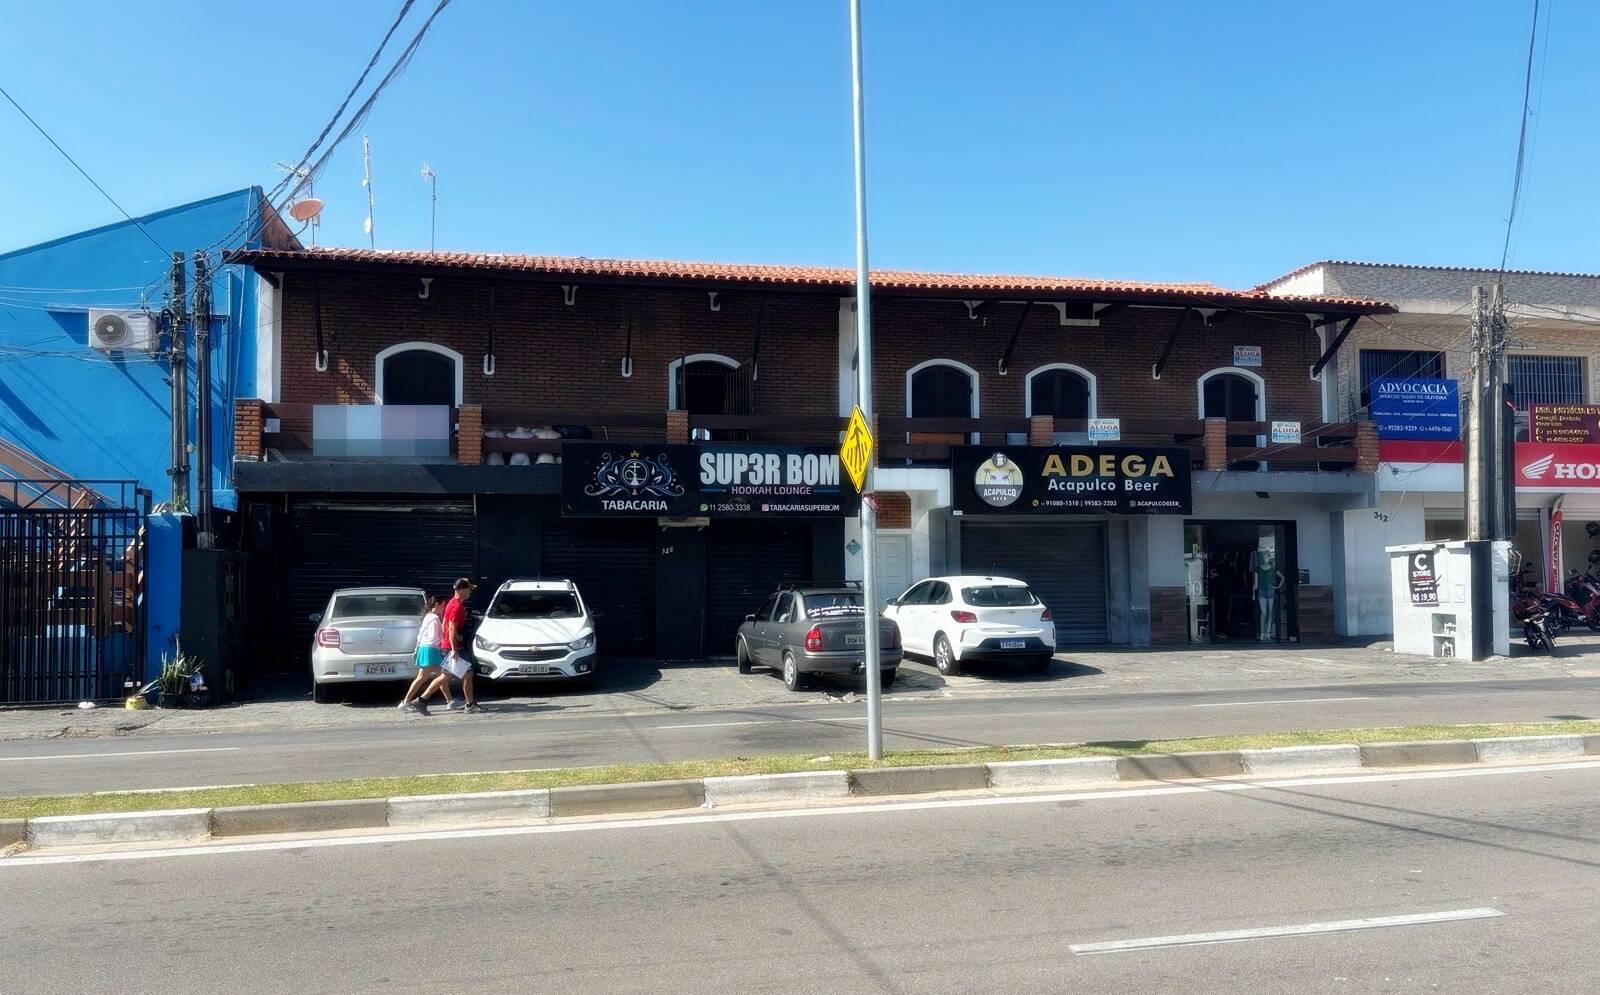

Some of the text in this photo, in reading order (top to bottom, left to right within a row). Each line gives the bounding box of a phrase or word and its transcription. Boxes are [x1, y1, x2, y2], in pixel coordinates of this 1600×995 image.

[1378, 382, 1448, 394] ADVOCACIA
[700, 452, 840, 486] SUP3R BOM
[1042, 454, 1174, 477] ADEGA
[731, 486, 812, 495] HOOKAH LOUNGE
[1048, 479, 1159, 493] Acapulco Beer
[983, 488, 1017, 498] ACAPULCO
[602, 500, 668, 511] TABACARIA
[1373, 511, 1388, 522] 312
[1414, 553, 1428, 571] C
